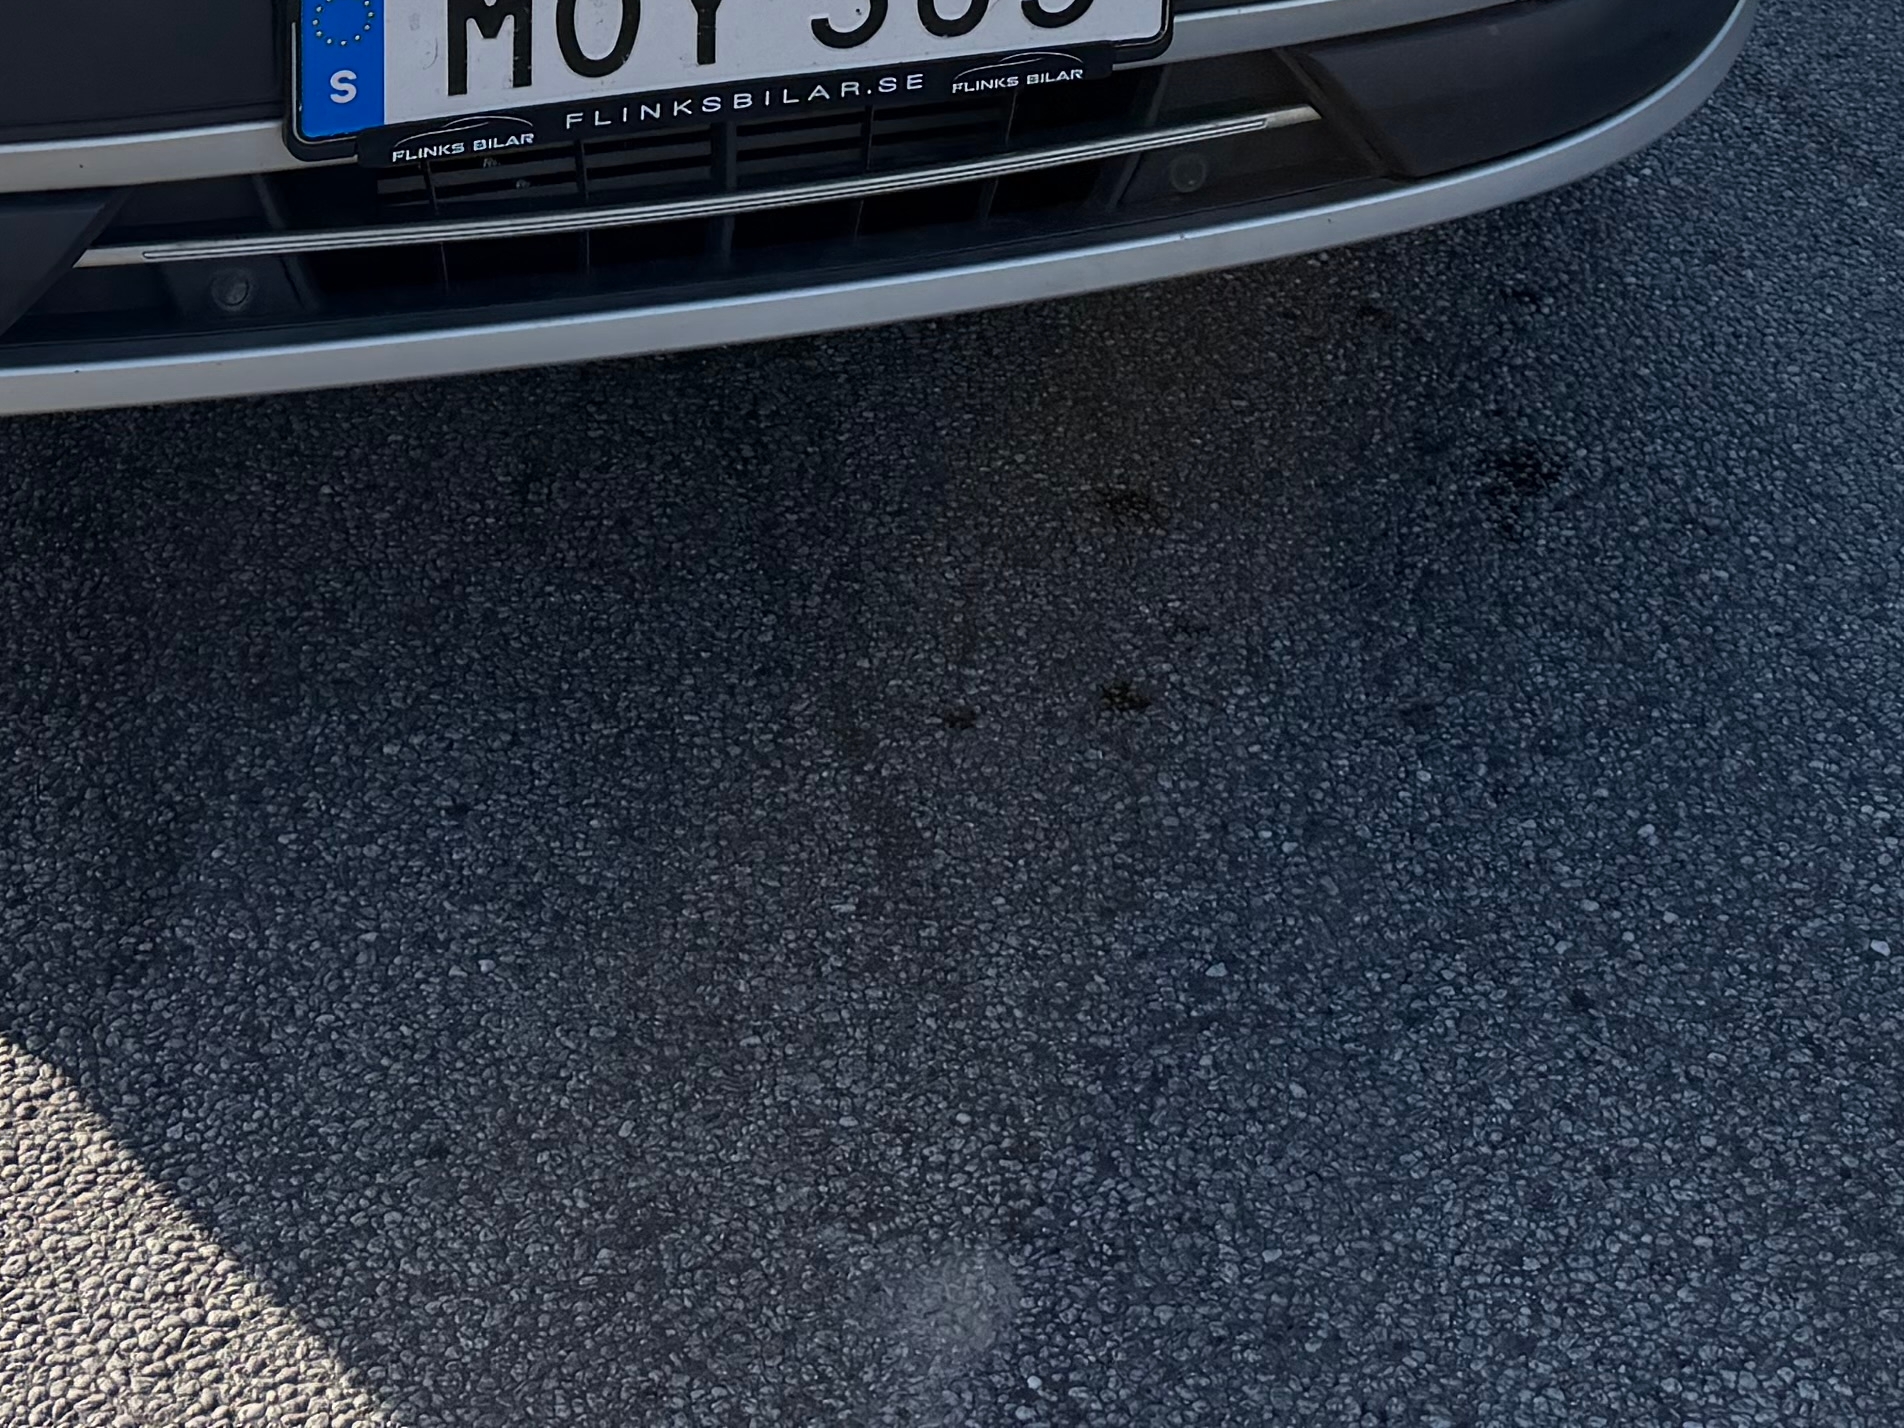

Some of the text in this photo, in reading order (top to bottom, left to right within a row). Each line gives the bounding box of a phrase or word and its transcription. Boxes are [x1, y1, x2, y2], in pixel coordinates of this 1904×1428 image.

[330, 70, 357, 103] S
[952, 68, 1084, 95] FLINKS BILAR
[566, 74, 924, 129] FLINKSBILAR.SE
[392, 133, 534, 162] FLINKS BILAR
